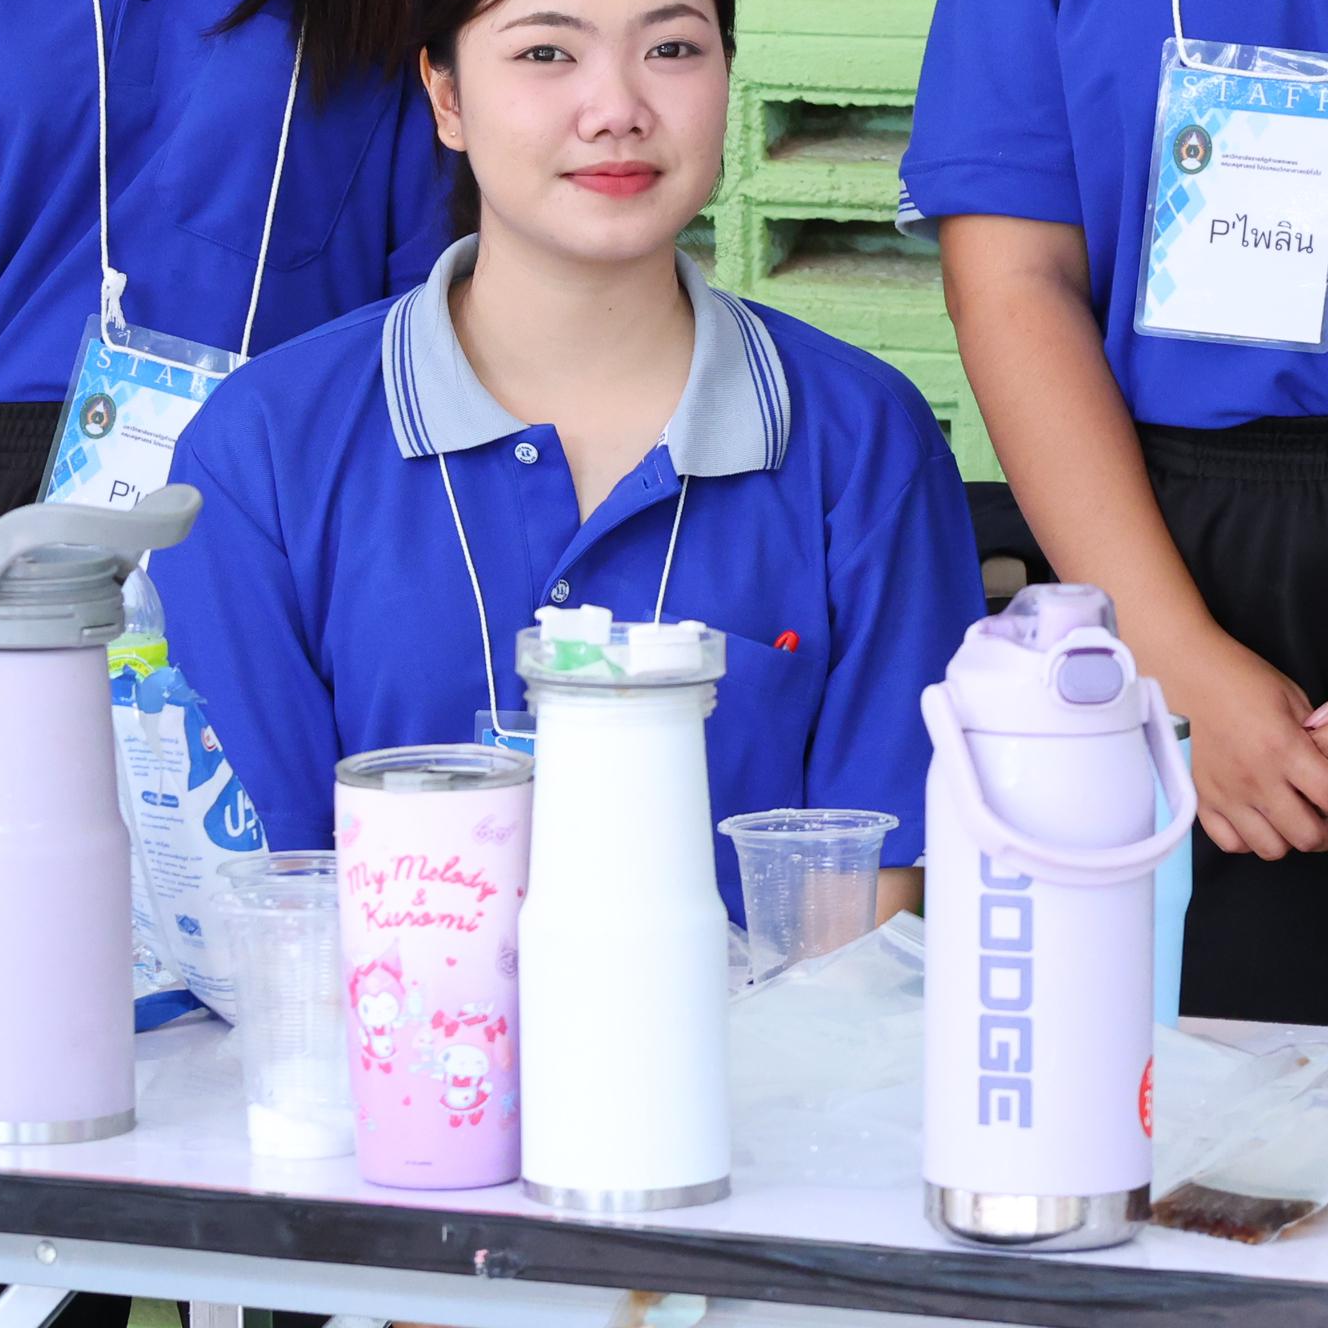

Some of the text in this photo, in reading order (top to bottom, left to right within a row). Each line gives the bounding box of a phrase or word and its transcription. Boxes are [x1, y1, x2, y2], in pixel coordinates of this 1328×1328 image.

[1209, 213, 1314, 254] P'ไพลิน
[348, 854, 497, 903] My Melody
[412, 888, 426, 906] &
[362, 901, 484, 933] Kuromi
